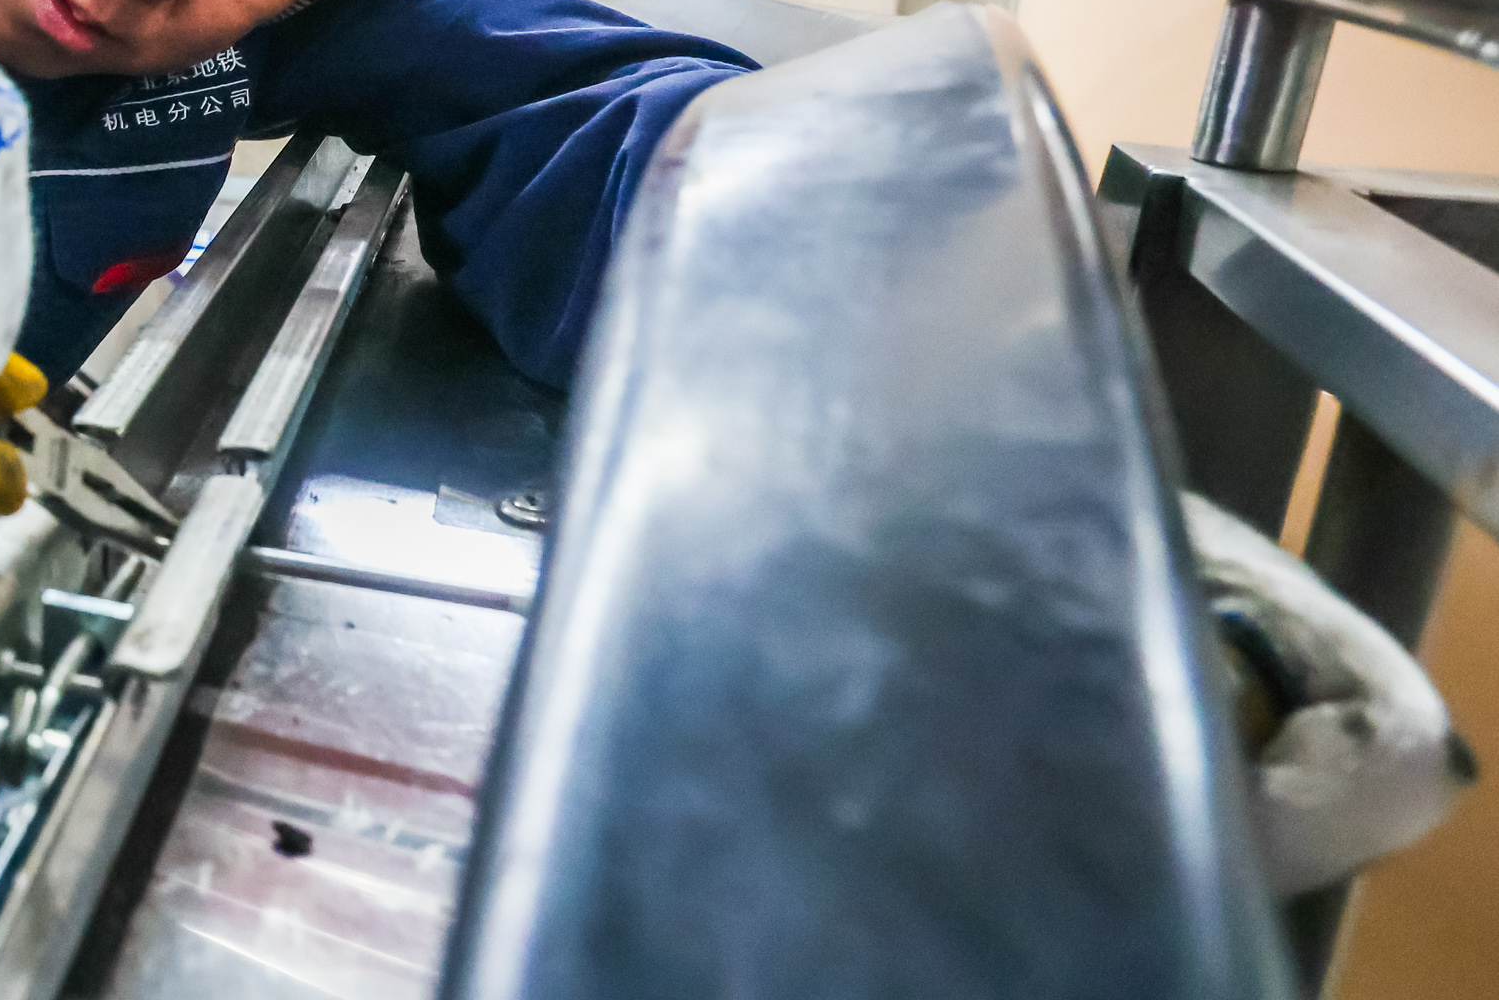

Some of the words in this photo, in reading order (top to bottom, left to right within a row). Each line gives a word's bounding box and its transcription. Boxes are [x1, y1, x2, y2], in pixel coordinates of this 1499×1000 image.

[101, 87, 251, 132] 机电分公司
